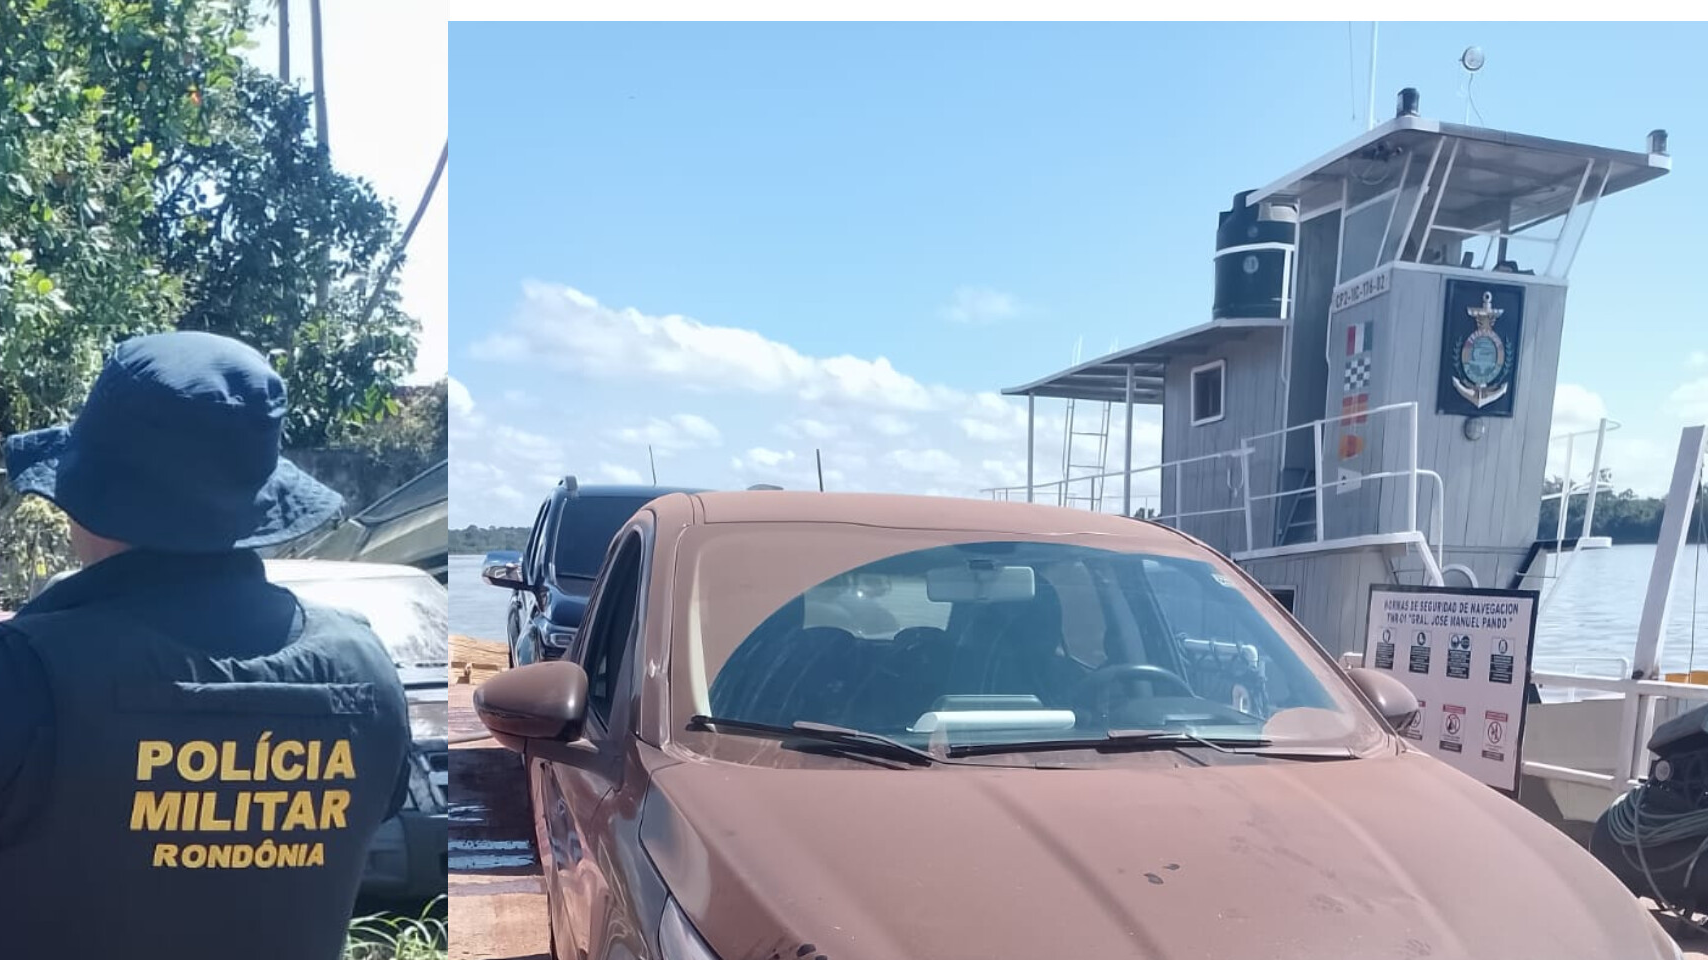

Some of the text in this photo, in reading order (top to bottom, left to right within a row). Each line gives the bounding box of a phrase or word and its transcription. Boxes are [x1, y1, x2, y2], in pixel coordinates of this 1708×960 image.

[1410, 601, 1419, 611] DE
[1420, 601, 1457, 614] SEGURIDAD
[1459, 602, 1468, 614] DE
[1450, 616, 1479, 628] MANUEL
[136, 731, 356, 782] POLÍCIA
[130, 789, 351, 831] MILITAR
[153, 838, 325, 868] RONDÔNIA
